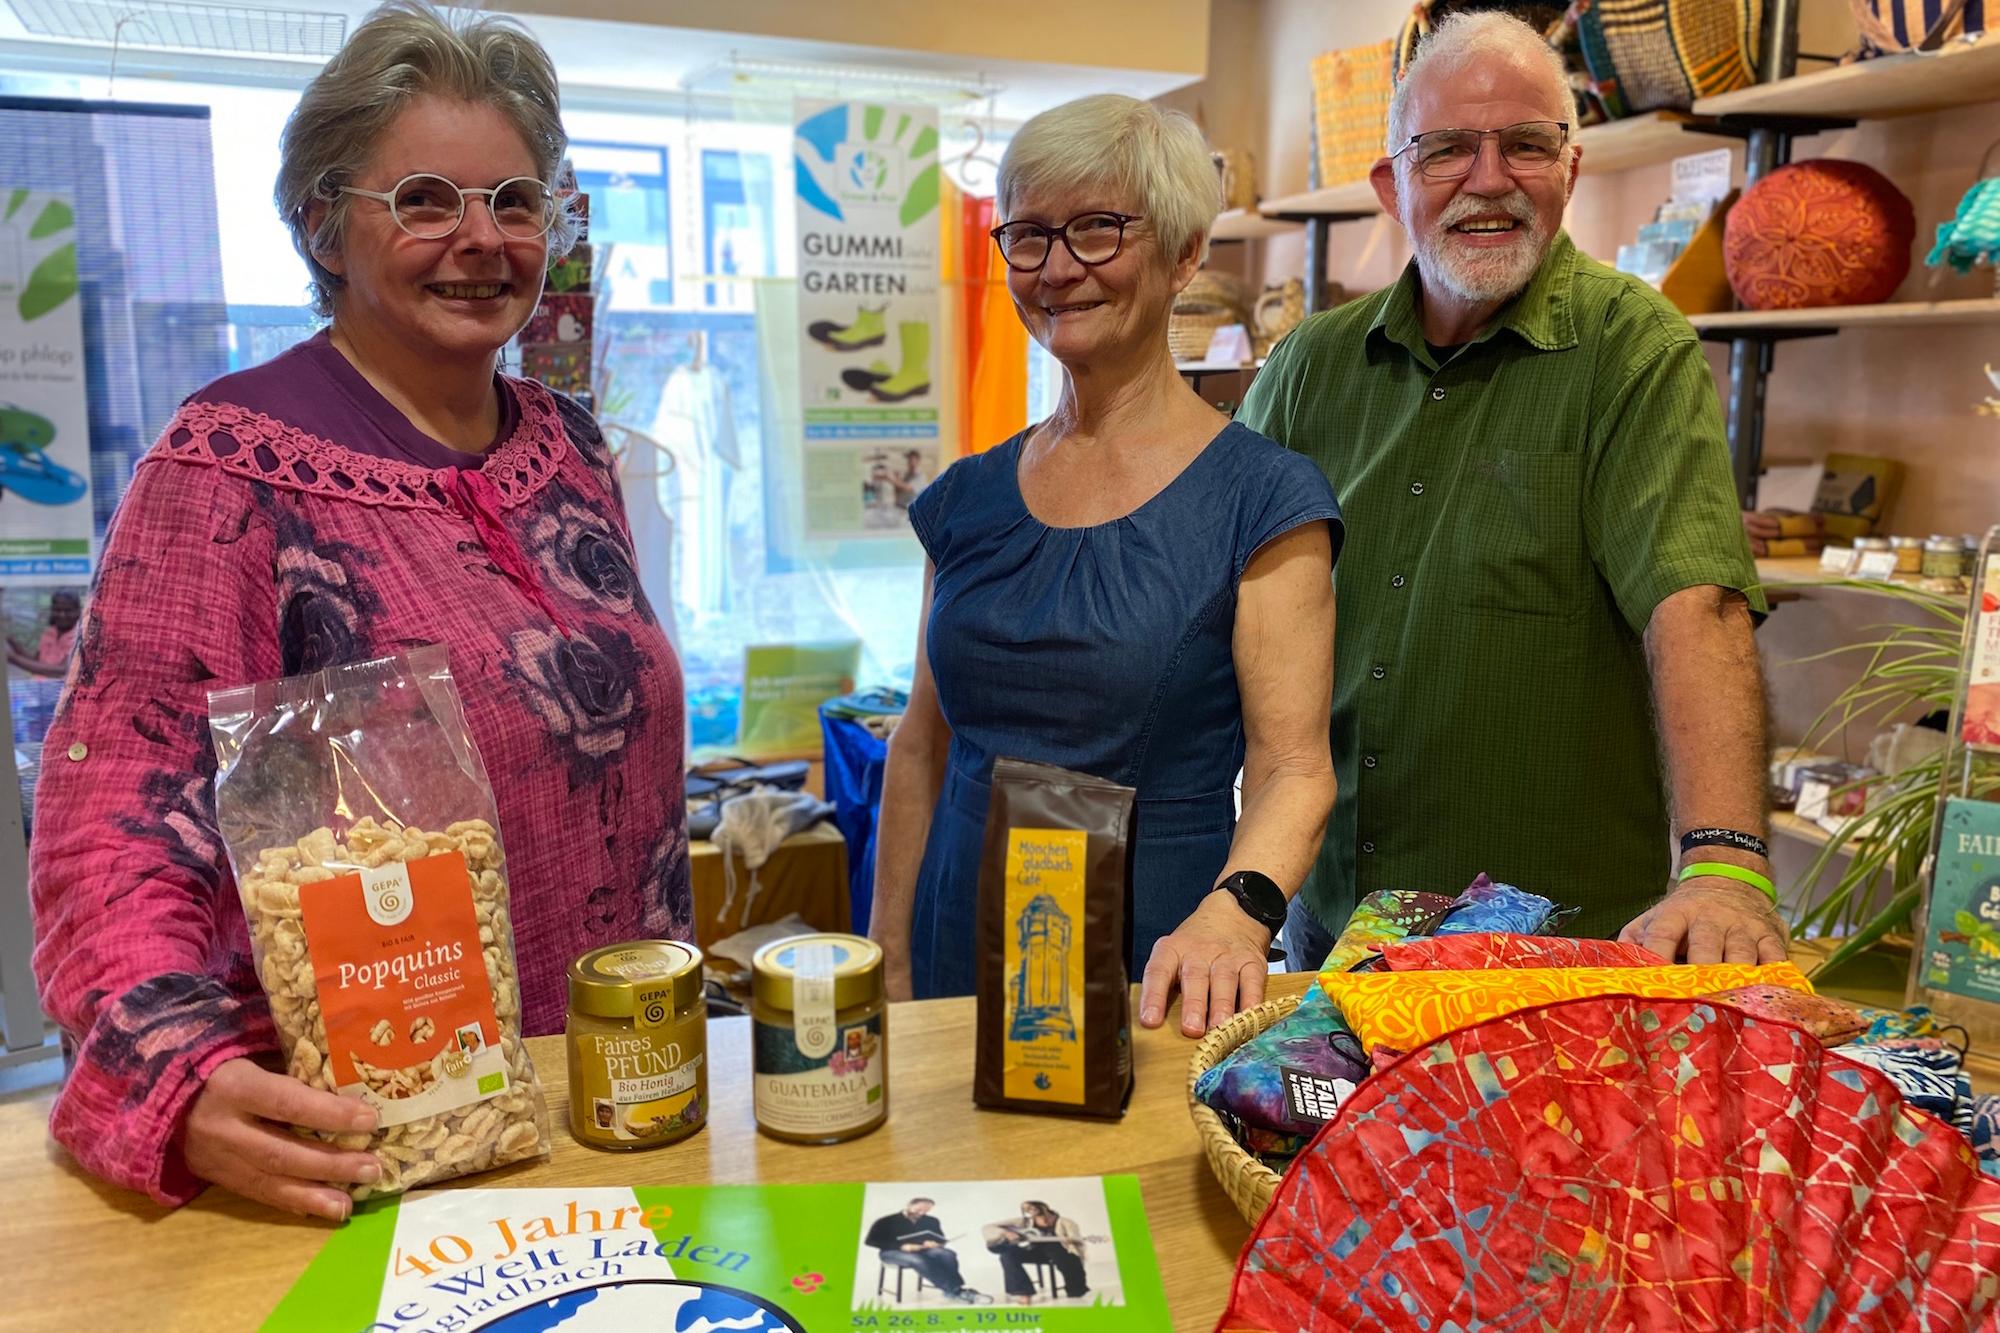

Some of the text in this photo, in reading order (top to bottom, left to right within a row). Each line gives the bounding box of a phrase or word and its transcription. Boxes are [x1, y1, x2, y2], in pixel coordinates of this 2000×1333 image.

[803, 232, 902, 259] GUMMI
[803, 271, 906, 295] GARTEN
[338, 941, 463, 989] Popquins
[414, 967, 460, 990] Classic
[594, 1036, 651, 1056] Faires
[605, 1043, 682, 1080] PFUND
[618, 1074, 674, 1093] Bio Honig
[769, 1075, 868, 1099] GUATEMALA
[1300, 1076, 1321, 1119] TRADE
[1314, 1079, 1338, 1120] FAIR
[394, 1201, 672, 1280] 40 Jahre
[424, 1248, 569, 1296] Welt
[589, 1235, 751, 1273] Laden
[418, 1260, 625, 1333] gladbach
[851, 1312, 1042, 1327] SA 26. 8. 19 Uhr
